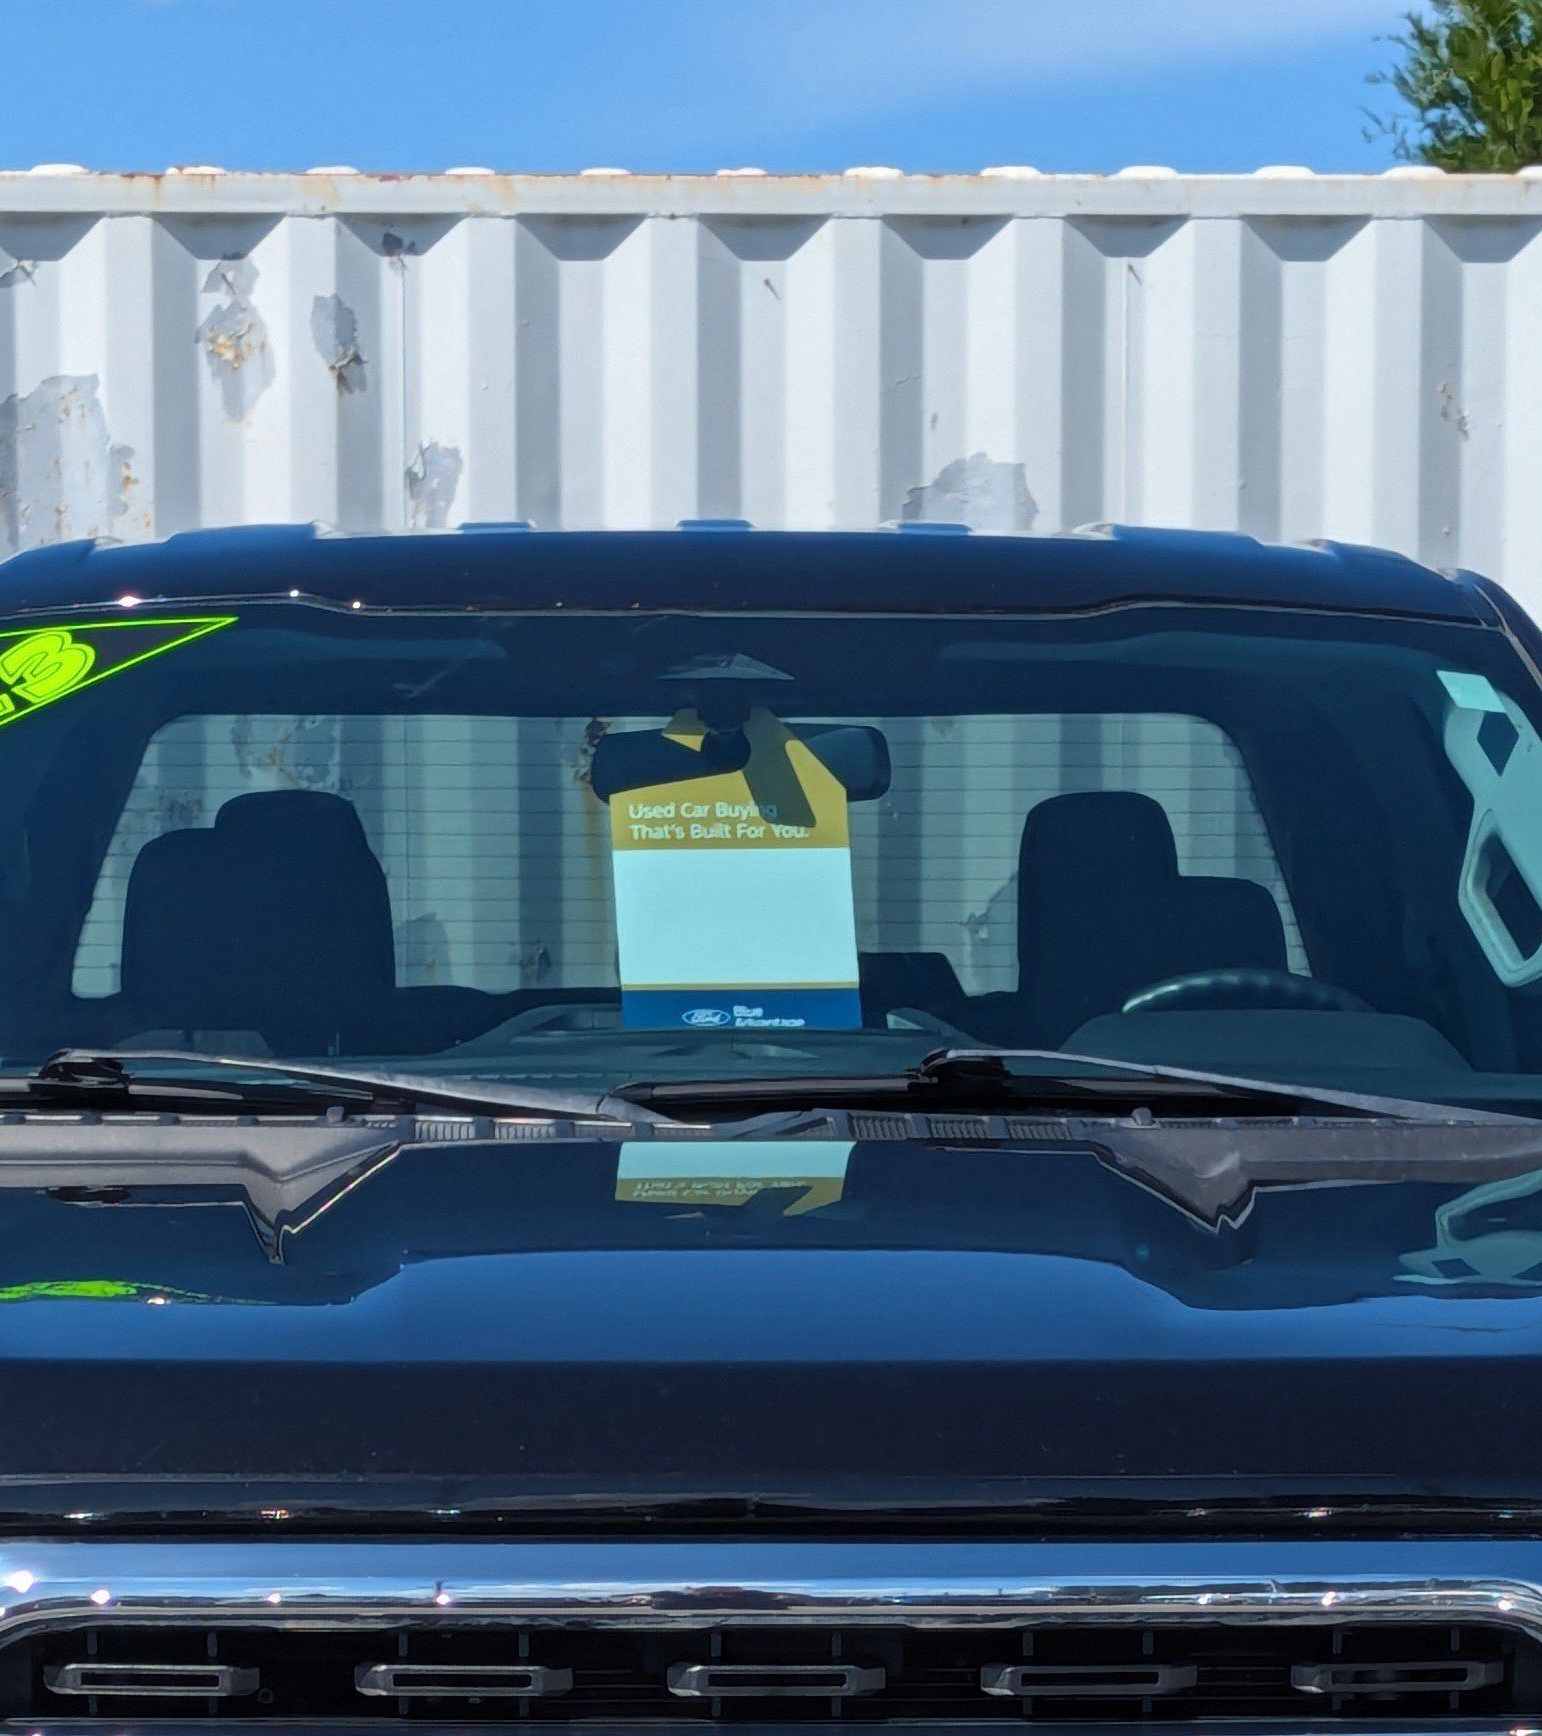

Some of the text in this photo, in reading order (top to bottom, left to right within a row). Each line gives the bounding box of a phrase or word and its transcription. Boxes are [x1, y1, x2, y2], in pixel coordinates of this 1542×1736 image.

[628, 801, 675, 819] Used
[680, 801, 710, 819] Car
[629, 822, 810, 840] That's Built For You.
